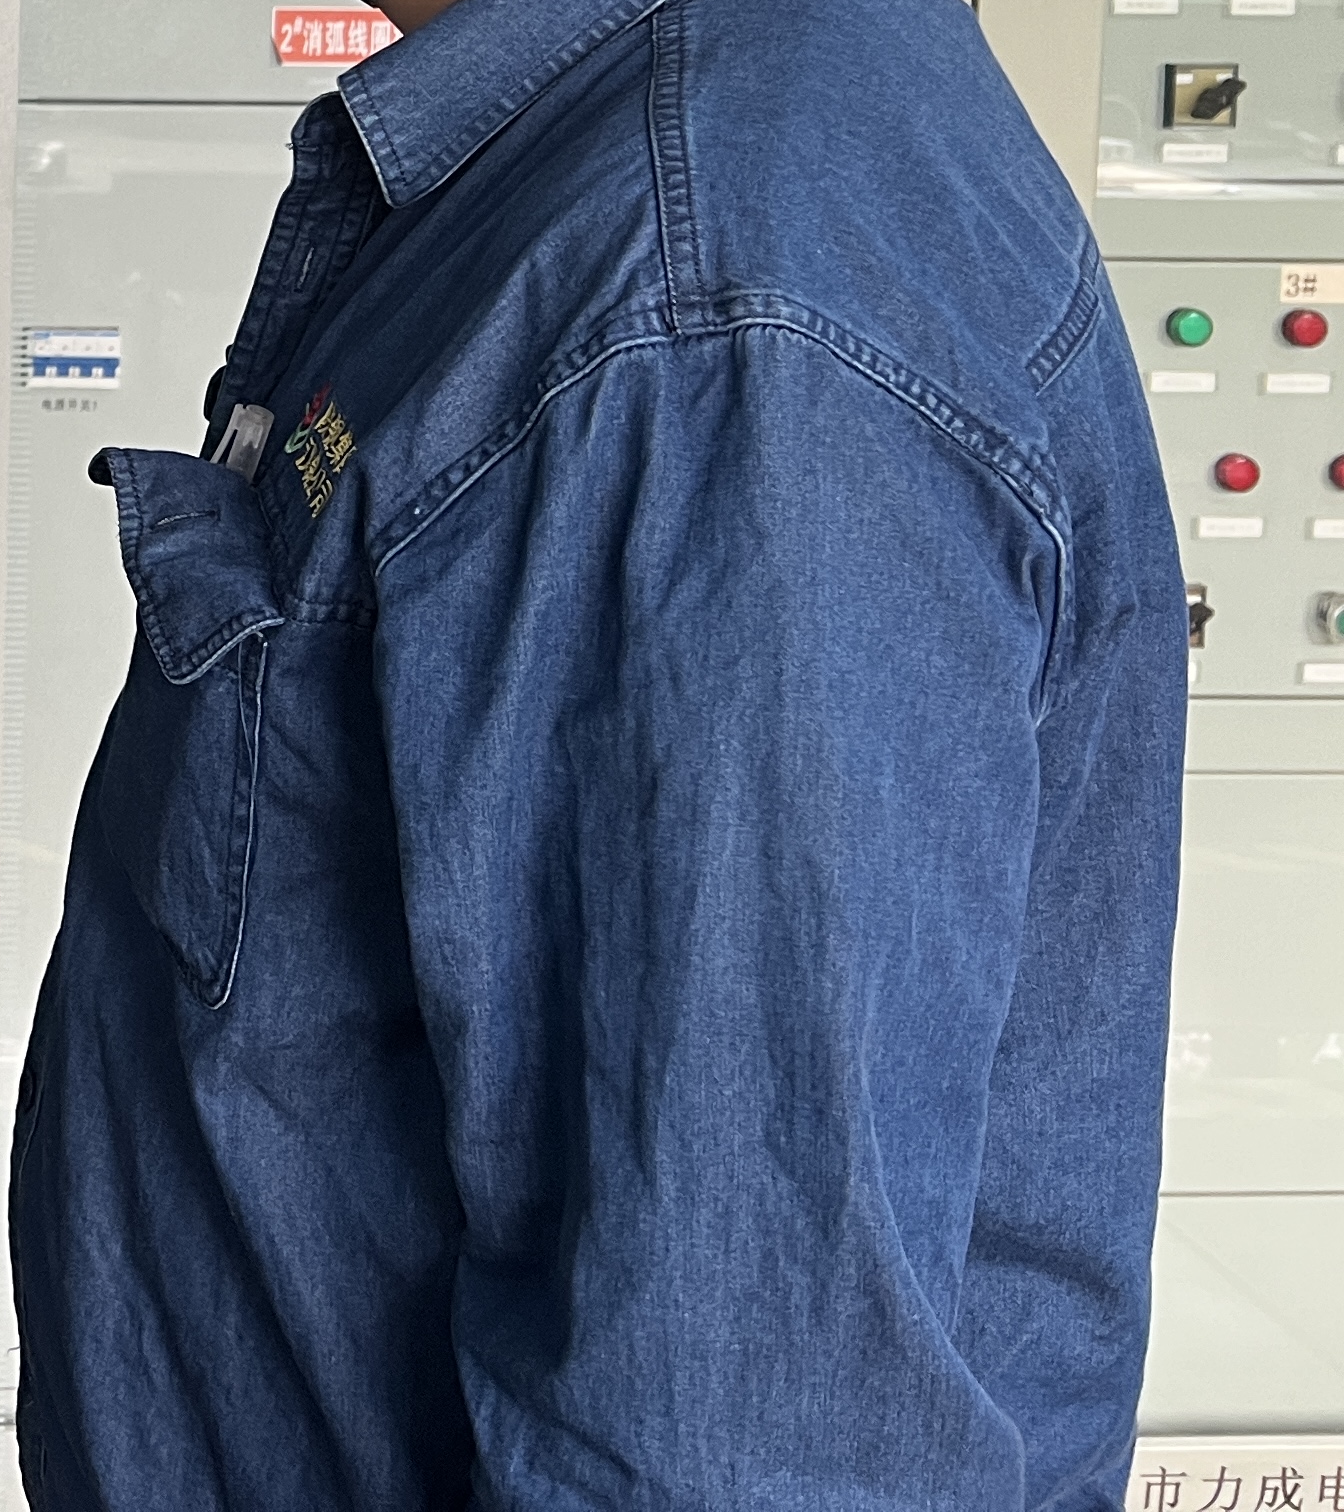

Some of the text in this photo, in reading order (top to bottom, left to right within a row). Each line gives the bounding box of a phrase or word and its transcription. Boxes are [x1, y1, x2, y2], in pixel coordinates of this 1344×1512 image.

[280, 15, 401, 57] 2#消弧线圈
[1285, 272, 1318, 298] 3#
